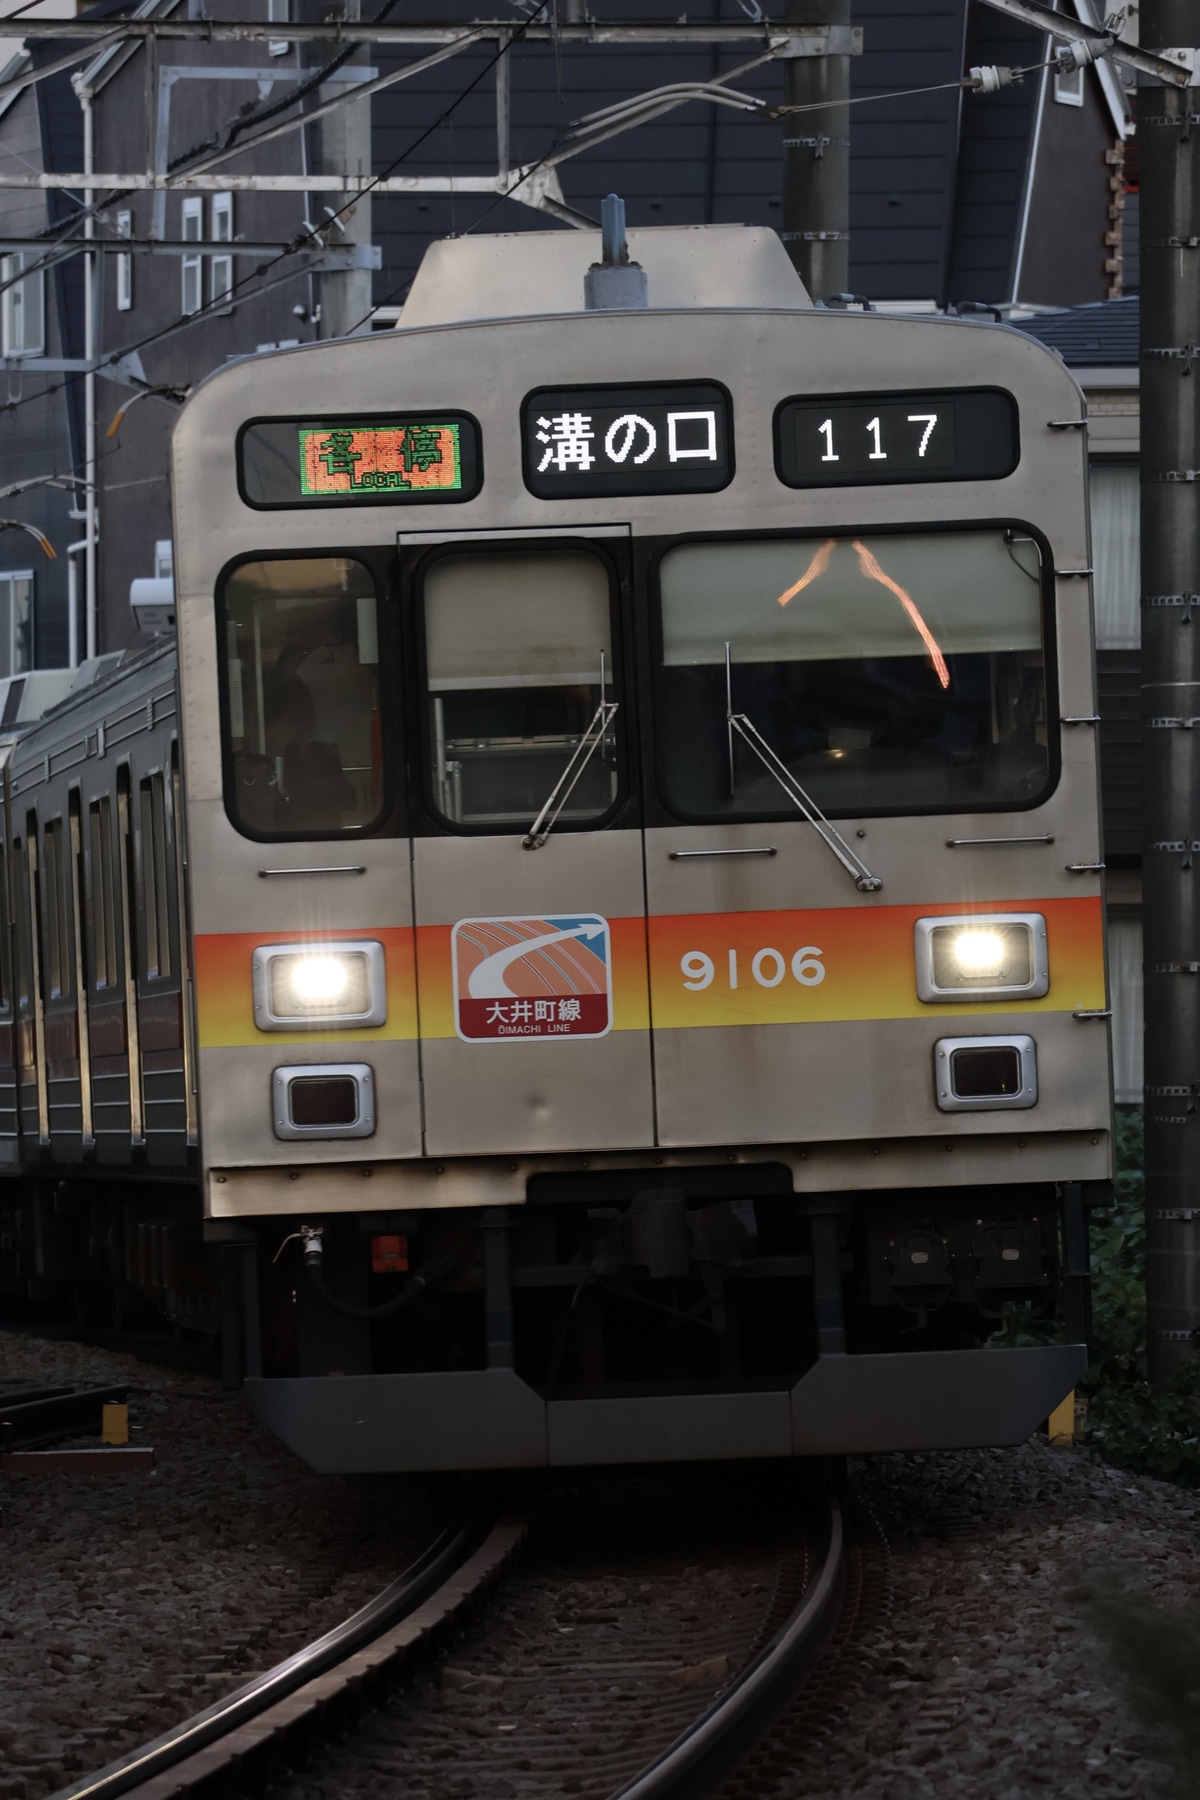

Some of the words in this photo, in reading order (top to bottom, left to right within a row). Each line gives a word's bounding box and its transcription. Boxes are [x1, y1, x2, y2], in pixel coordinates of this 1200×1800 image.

[535, 411, 717, 472] 溝の口
[818, 414, 938, 462] 117
[351, 472, 411, 489] LOCAL
[680, 946, 826, 991] 9106
[485, 998, 581, 1024] 大井町線
[547, 1023, 571, 1033] LINE
